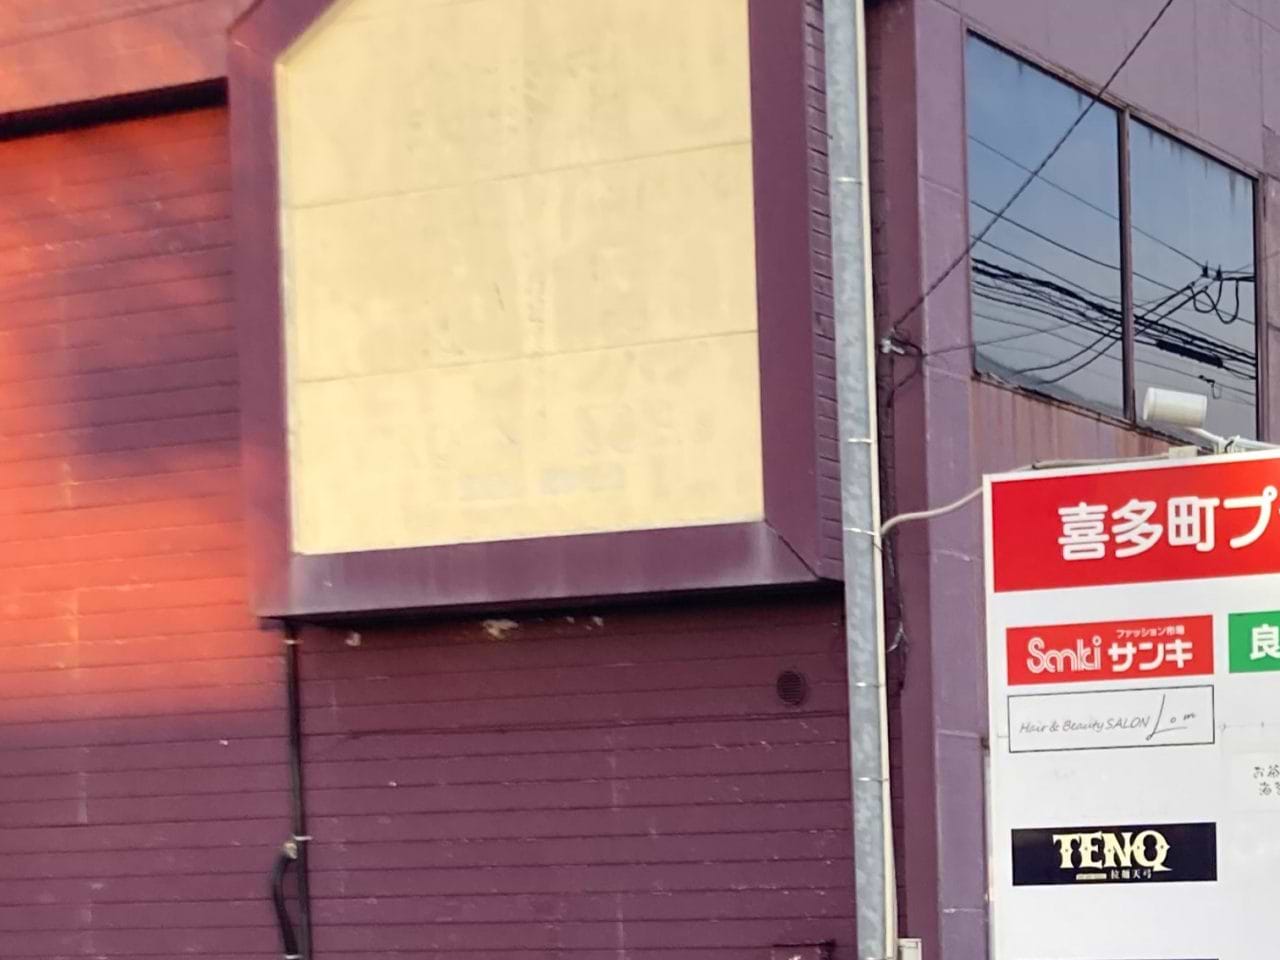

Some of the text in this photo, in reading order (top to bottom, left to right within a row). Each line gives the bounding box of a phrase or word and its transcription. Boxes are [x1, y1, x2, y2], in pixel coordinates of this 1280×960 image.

[1108, 637, 1194, 672] サンキ
[1019, 720, 1049, 734] Hair
[1062, 719, 1105, 733] Beauty
[1105, 716, 1151, 731] SALON
[1052, 829, 1173, 872] TENQ
